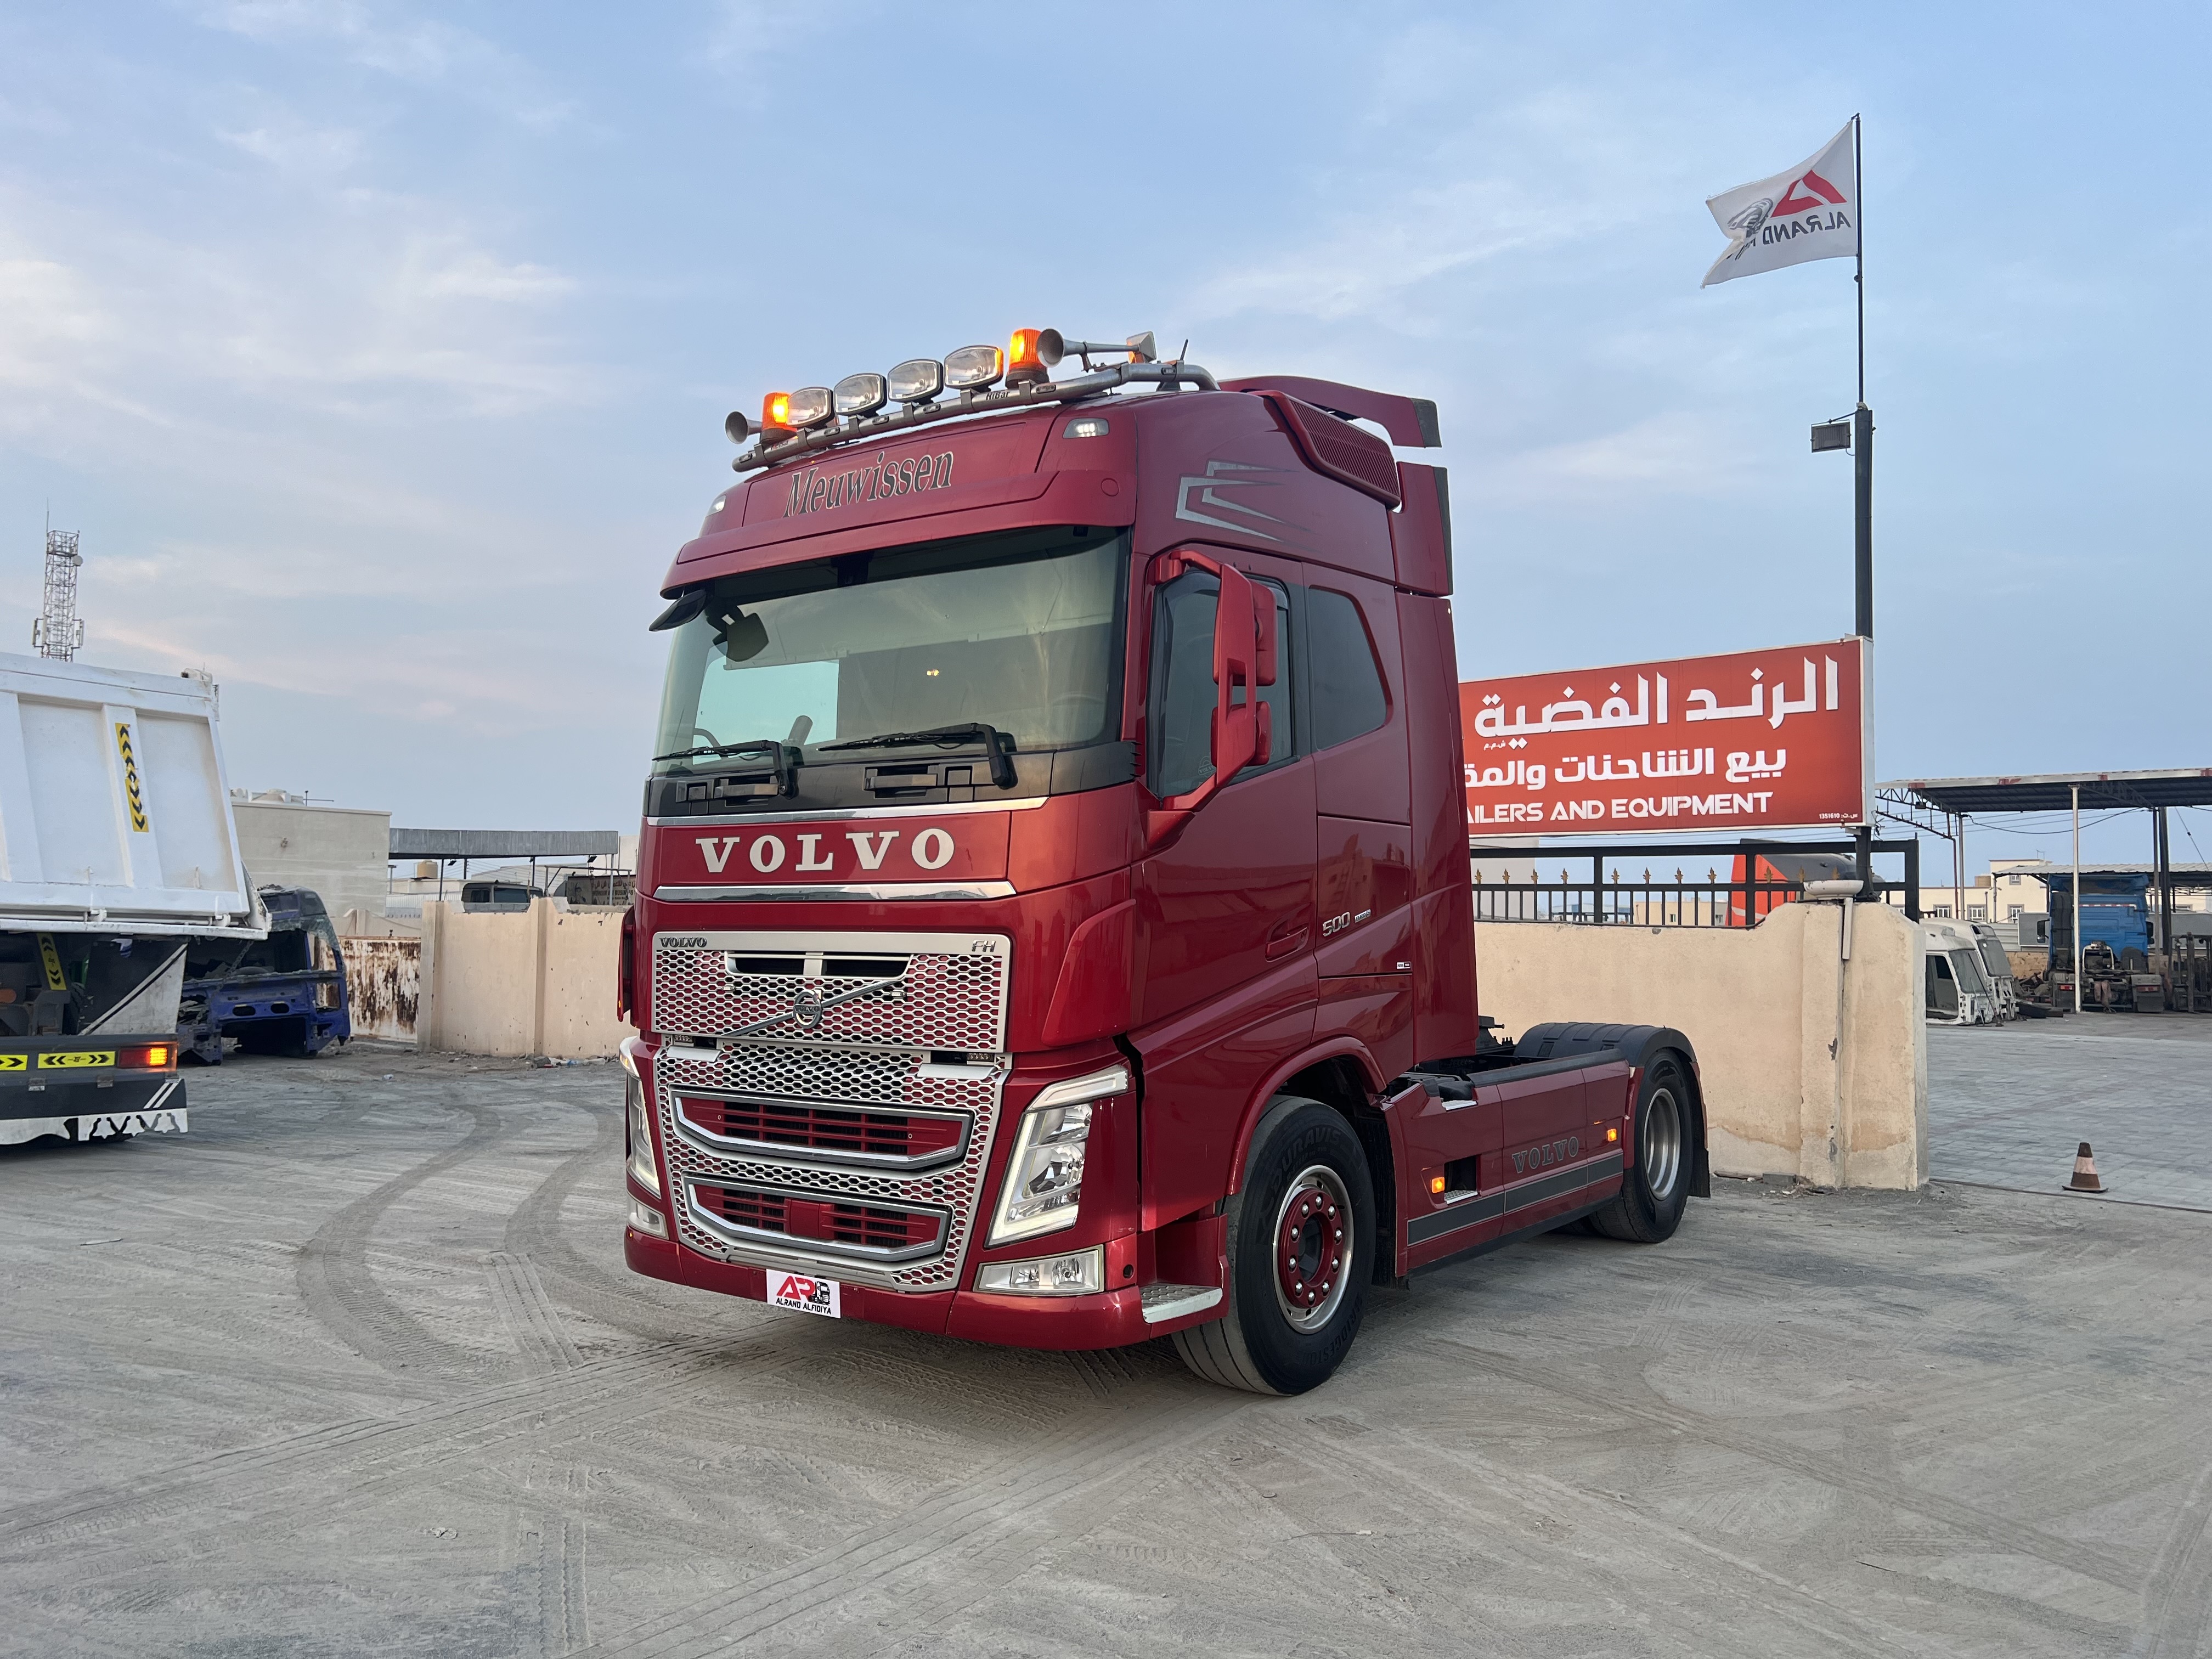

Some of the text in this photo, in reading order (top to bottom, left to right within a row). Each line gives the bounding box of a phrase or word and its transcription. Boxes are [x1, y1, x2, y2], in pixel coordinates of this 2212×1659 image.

[783, 451, 955, 518] Meuwissen
[1474, 653, 1838, 750] الرند الفضية
[1464, 747, 1786, 791] بيع الشاحنات والمق
[1550, 799, 1605, 821] AND
[1611, 791, 1774, 819] EQUIPMENT
[695, 828, 955, 873] VOLVO
[659, 936, 707, 948] VOLVO
[1322, 911, 1351, 937] 500
[972, 940, 996, 952] FH
[1273, 1126, 1341, 1194] DURAVIS
[1511, 1136, 1579, 1174] VOLVO
[776, 1297, 832, 1315] ALRAND ALFIDIYA
